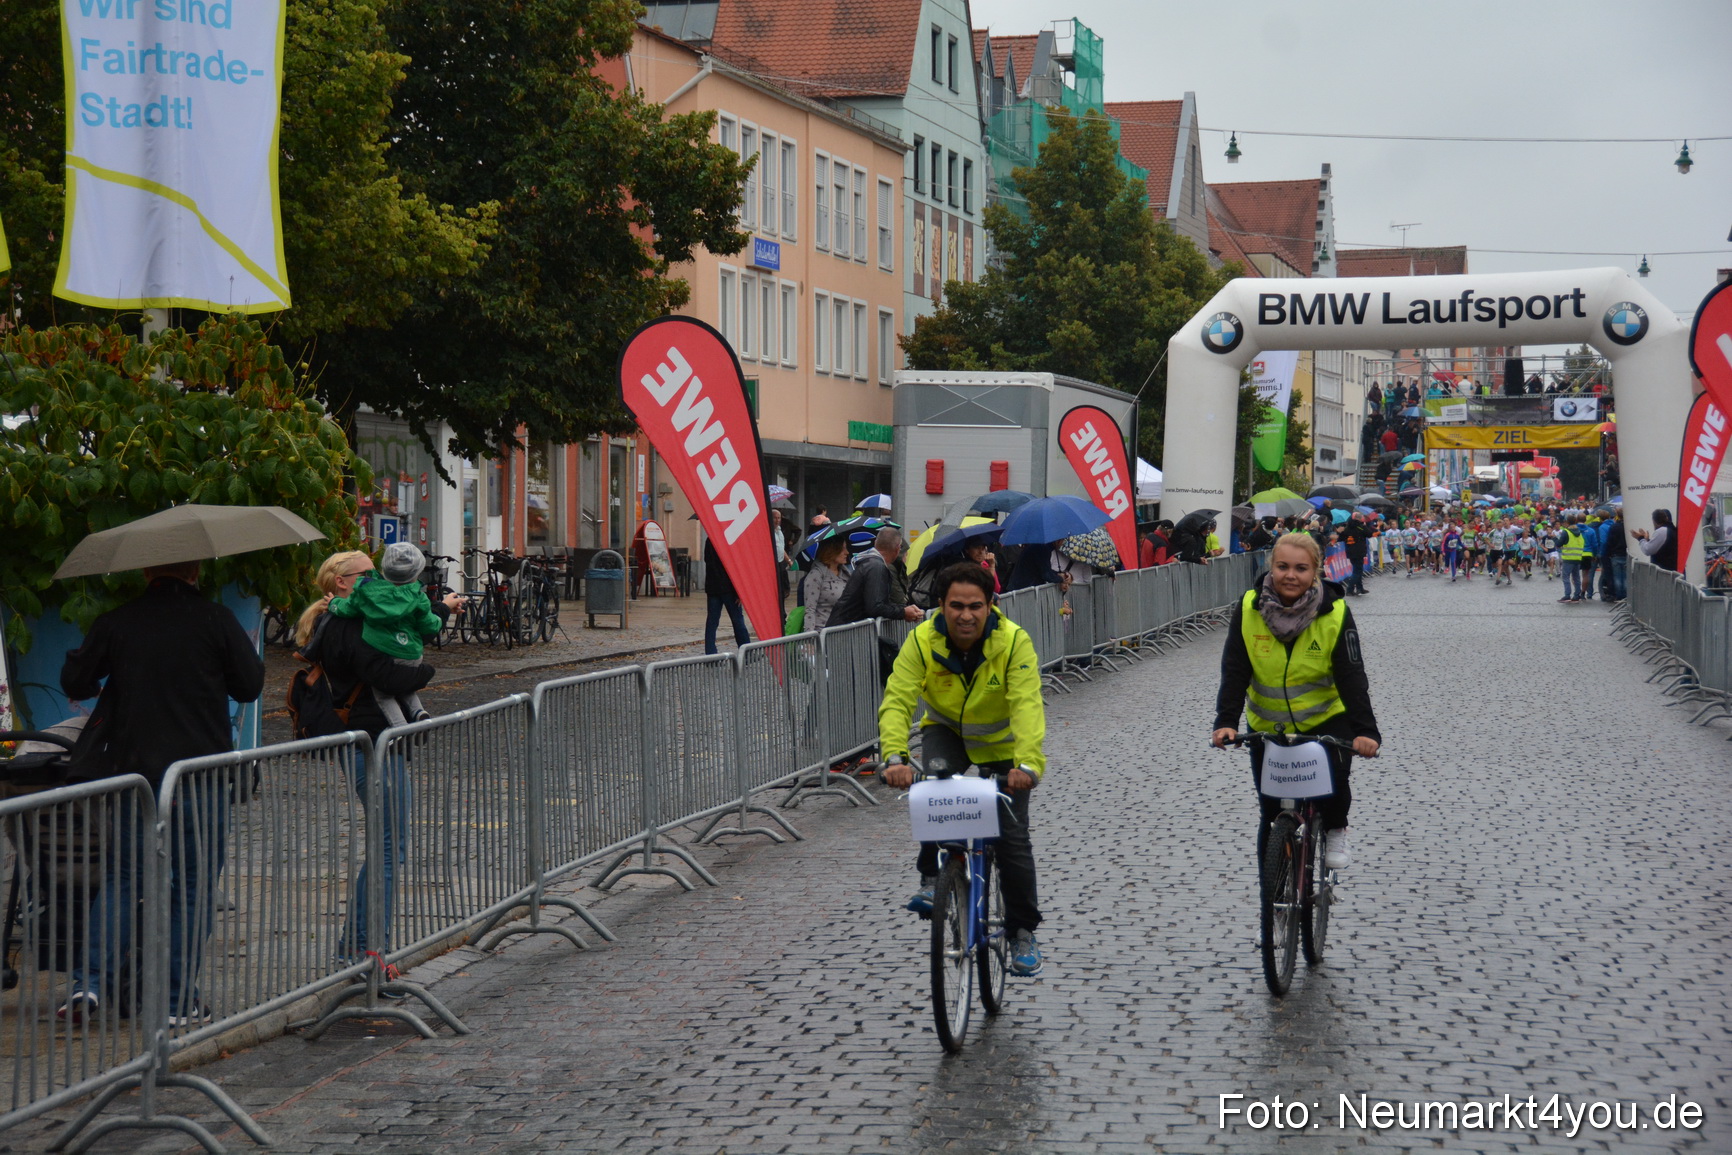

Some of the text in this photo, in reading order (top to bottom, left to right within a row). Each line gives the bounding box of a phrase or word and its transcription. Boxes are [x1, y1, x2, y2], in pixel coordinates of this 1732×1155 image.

[154, 0, 232, 30] sind
[80, 37, 265, 85] Fairtrade-
[80, 92, 193, 130] Stadt!
[1259, 288, 1587, 328] BMW Laufsport
[1608, 302, 1646, 317] BMW
[1204, 313, 1239, 328] BMW
[1493, 430, 1533, 444] ZIEL
[1683, 403, 1725, 507] REWE
[1165, 487, 1224, 495] www.bmw-laufsport.de
[384, 523, 394, 540] P
[1268, 758, 1318, 769] Erster Mann
[1270, 772, 1317, 783] Jugendlauf
[928, 796, 978, 806] Erste Frau
[928, 810, 982, 823] Jugendlauf
